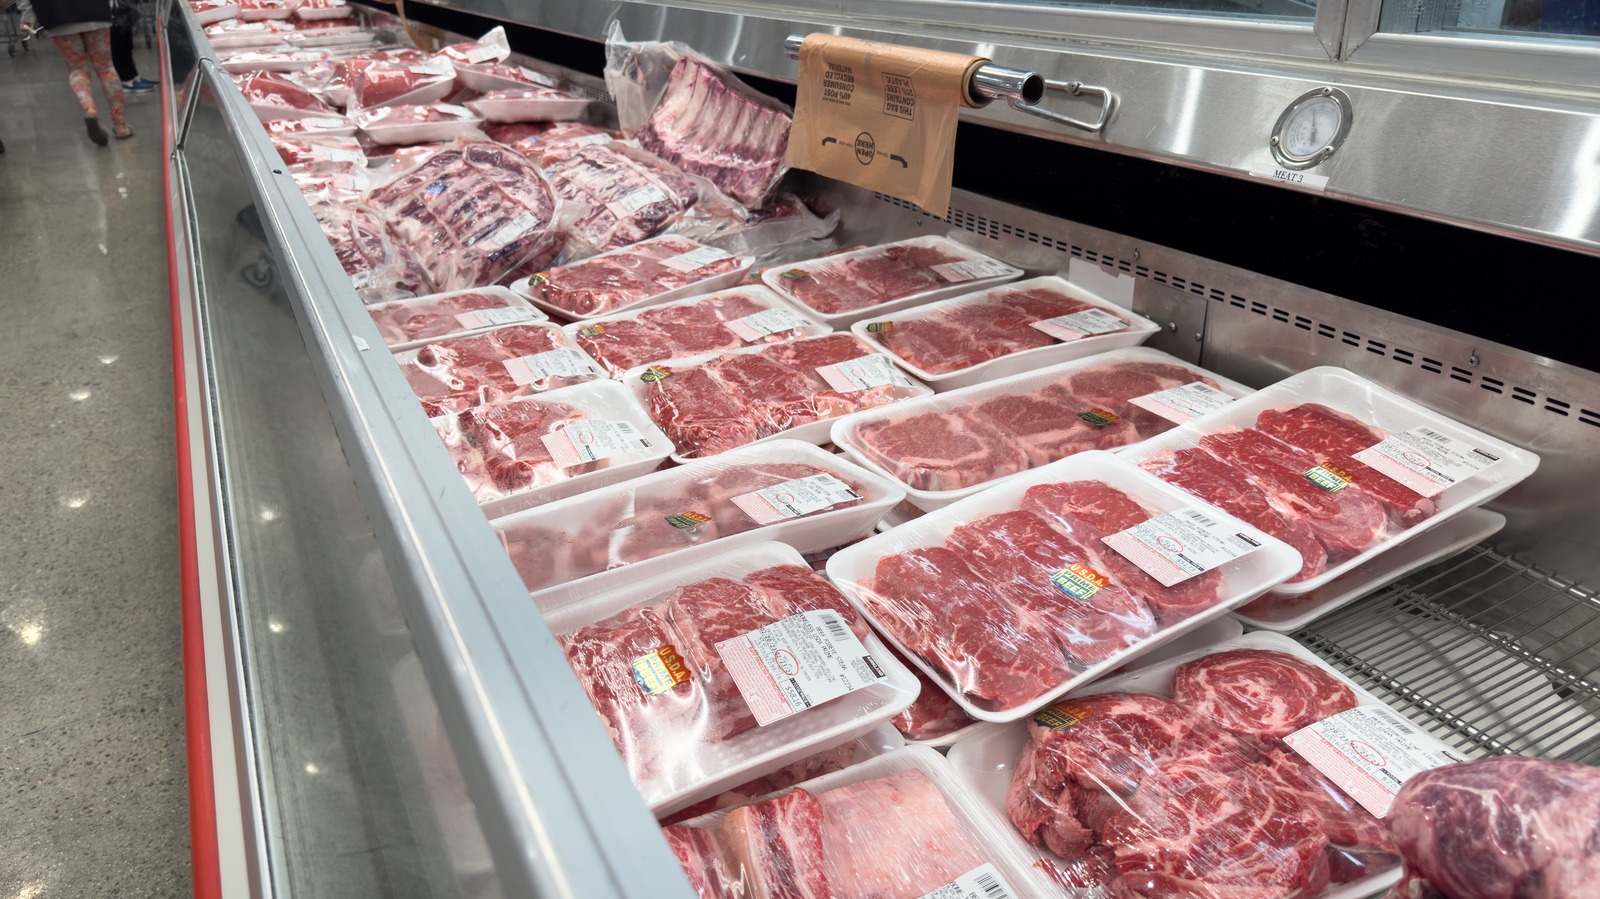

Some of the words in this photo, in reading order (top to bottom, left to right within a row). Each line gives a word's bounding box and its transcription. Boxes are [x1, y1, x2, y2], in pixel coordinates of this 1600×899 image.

[828, 62, 852, 74] MATERIAL
[825, 71, 854, 82] RECYCLED
[886, 76, 909, 87] PLASTIC
[824, 80, 854, 92] CONSUMER
[886, 84, 901, 94] LESS
[824, 89, 838, 98] POST
[840, 92, 851, 100] 40%
[886, 93, 914, 106] CONTAINS
[886, 102, 898, 112] BAG
[900, 107, 912, 116] THIS
[857, 140, 874, 149] HERE
[856, 148, 873, 158] OPEN
[1272, 169, 1298, 181] MEAT
[1309, 474, 1337, 488] BEEF
[1316, 468, 1346, 484] PRIME
[1056, 576, 1086, 596] BEEF
[1064, 570, 1096, 592] PRIME
[820, 645, 833, 660] PRIME
[651, 655, 673, 686] PRIME
[660, 647, 686, 682] U.S.D.A.
[784, 686, 802, 707] $58.16
[1036, 713, 1063, 726] BEEF
[1048, 707, 1075, 722] PRIME
